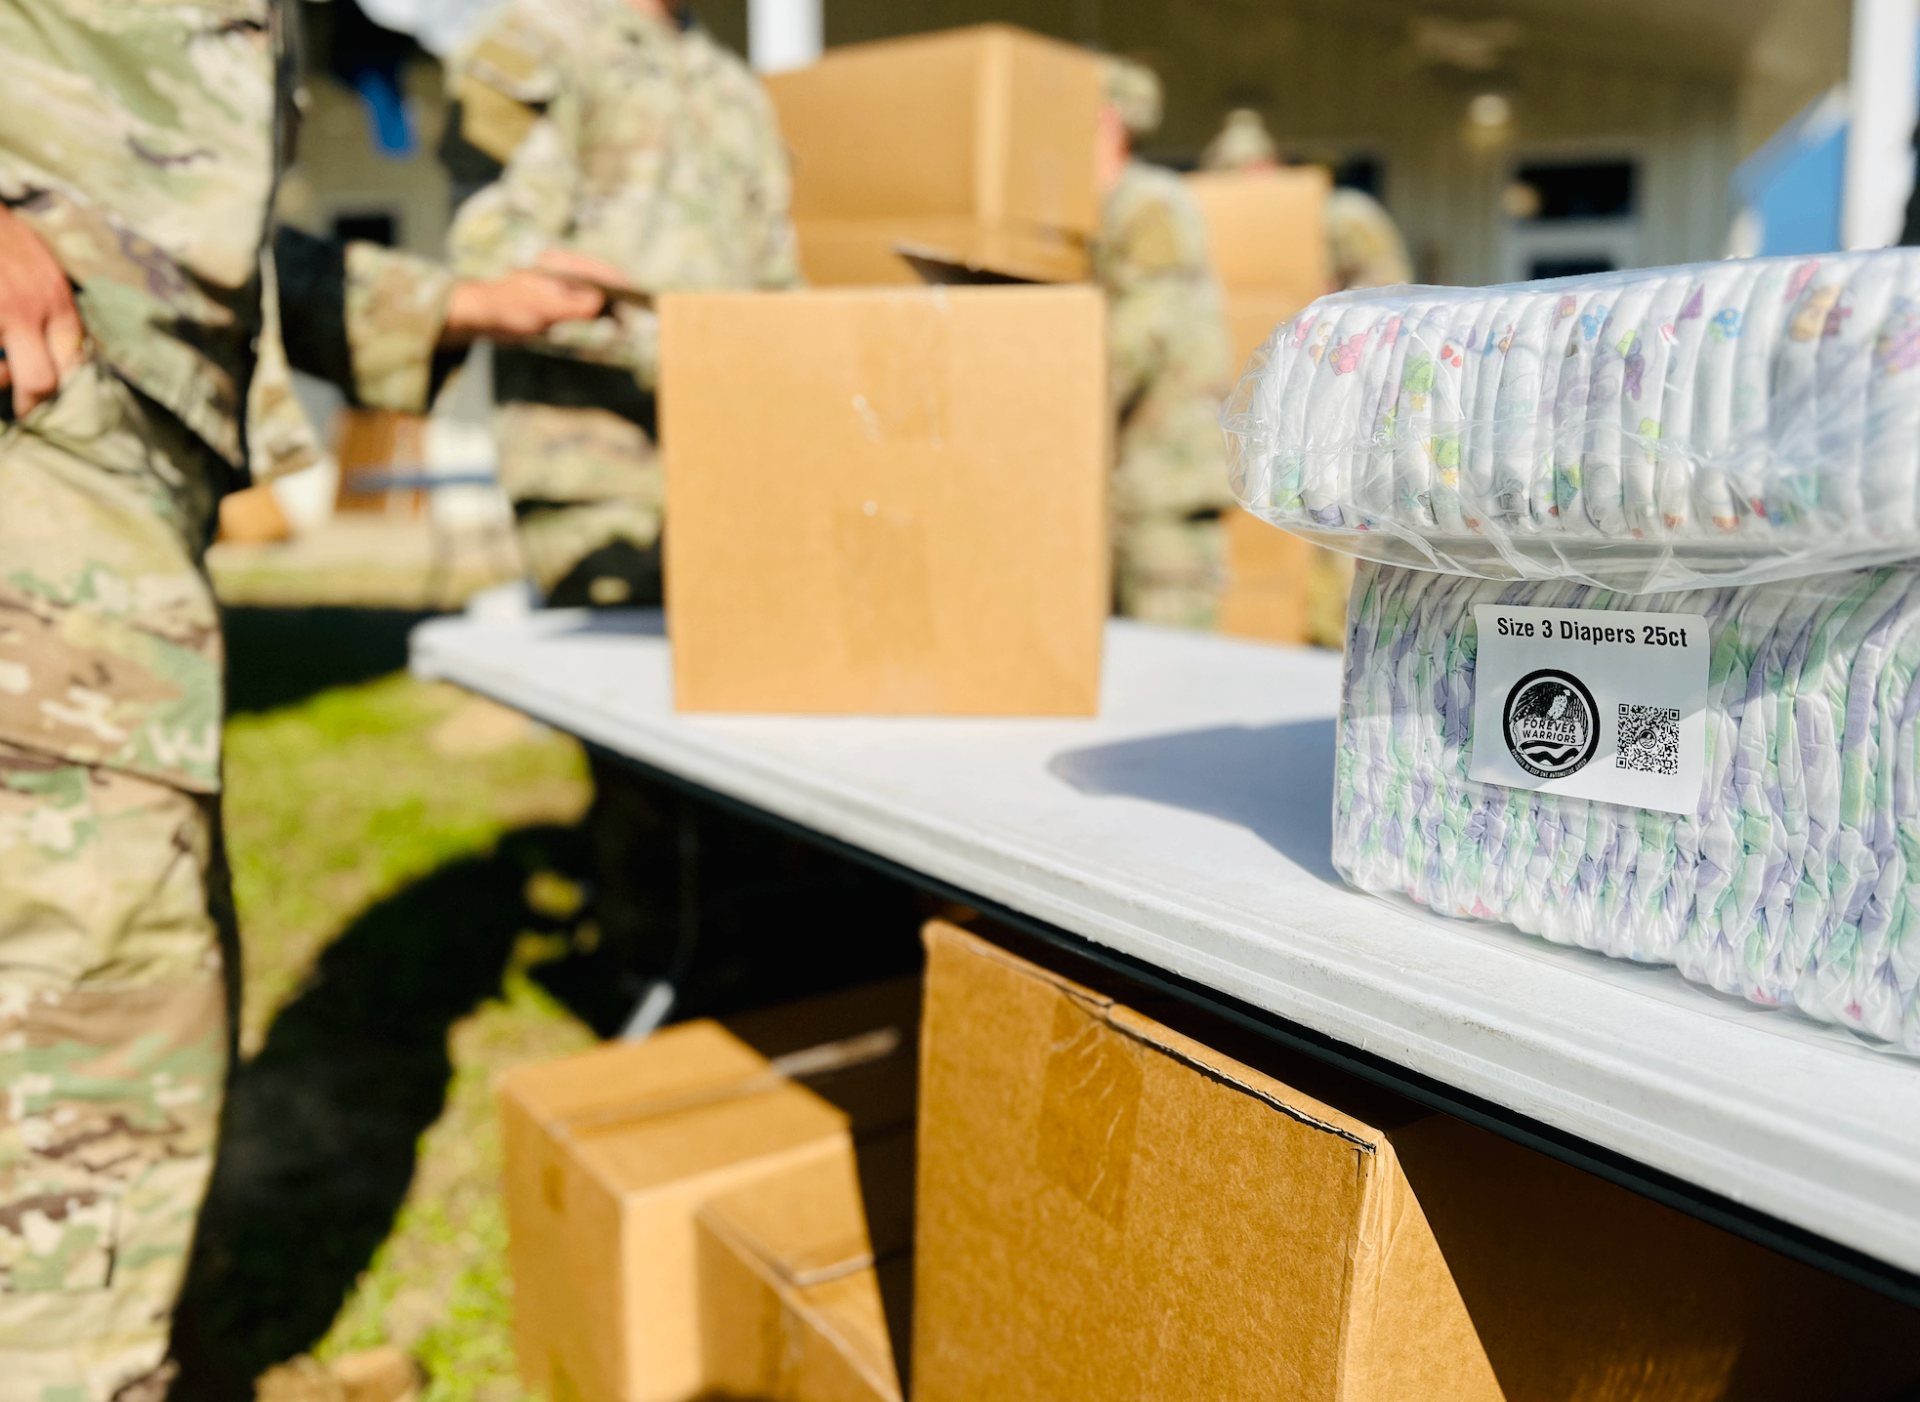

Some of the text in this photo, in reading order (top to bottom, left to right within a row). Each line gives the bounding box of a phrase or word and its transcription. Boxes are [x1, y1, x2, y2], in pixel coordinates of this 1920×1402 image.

[1497, 617, 1688, 648] Size 3 Diapers 25ct
[1523, 718, 1576, 734] FOREVER
[1522, 730, 1576, 744] WARRIORS
